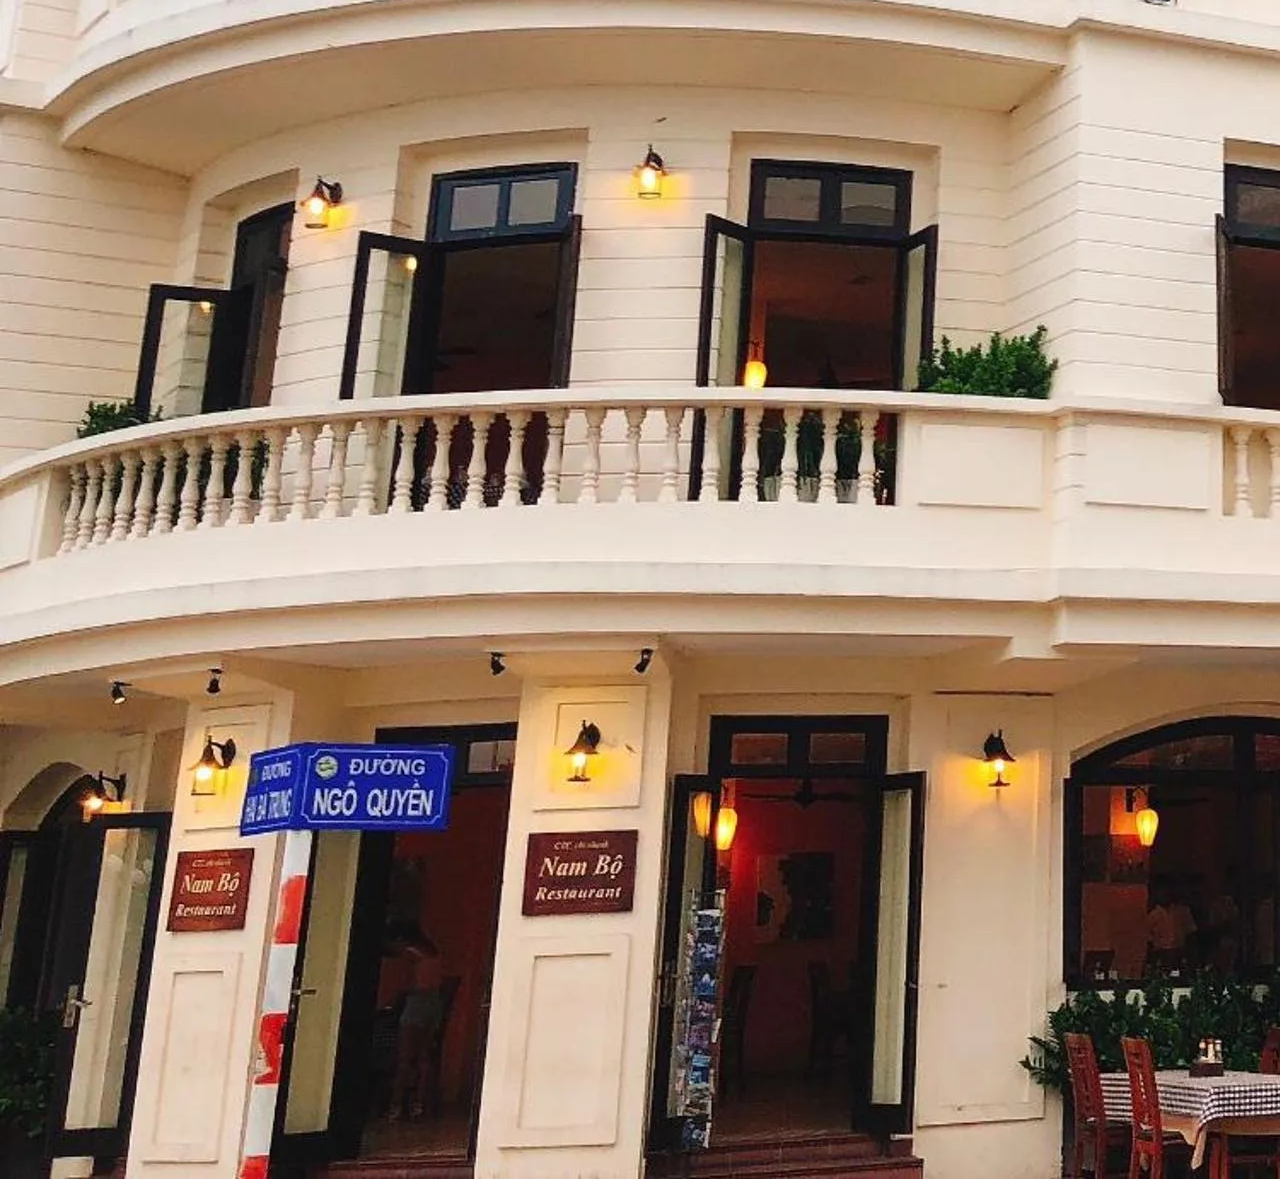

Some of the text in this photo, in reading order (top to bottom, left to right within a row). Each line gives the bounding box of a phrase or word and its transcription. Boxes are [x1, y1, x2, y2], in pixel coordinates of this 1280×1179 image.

[349, 754, 426, 776] ĐƯỜNG
[312, 778, 434, 817] NGÔ QUYỀN
[538, 854, 624, 880] Nam Bộ
[180, 871, 240, 897] Nam Bộ
[535, 886, 622, 901] Restaurant
[175, 903, 237, 917] Restaurant
